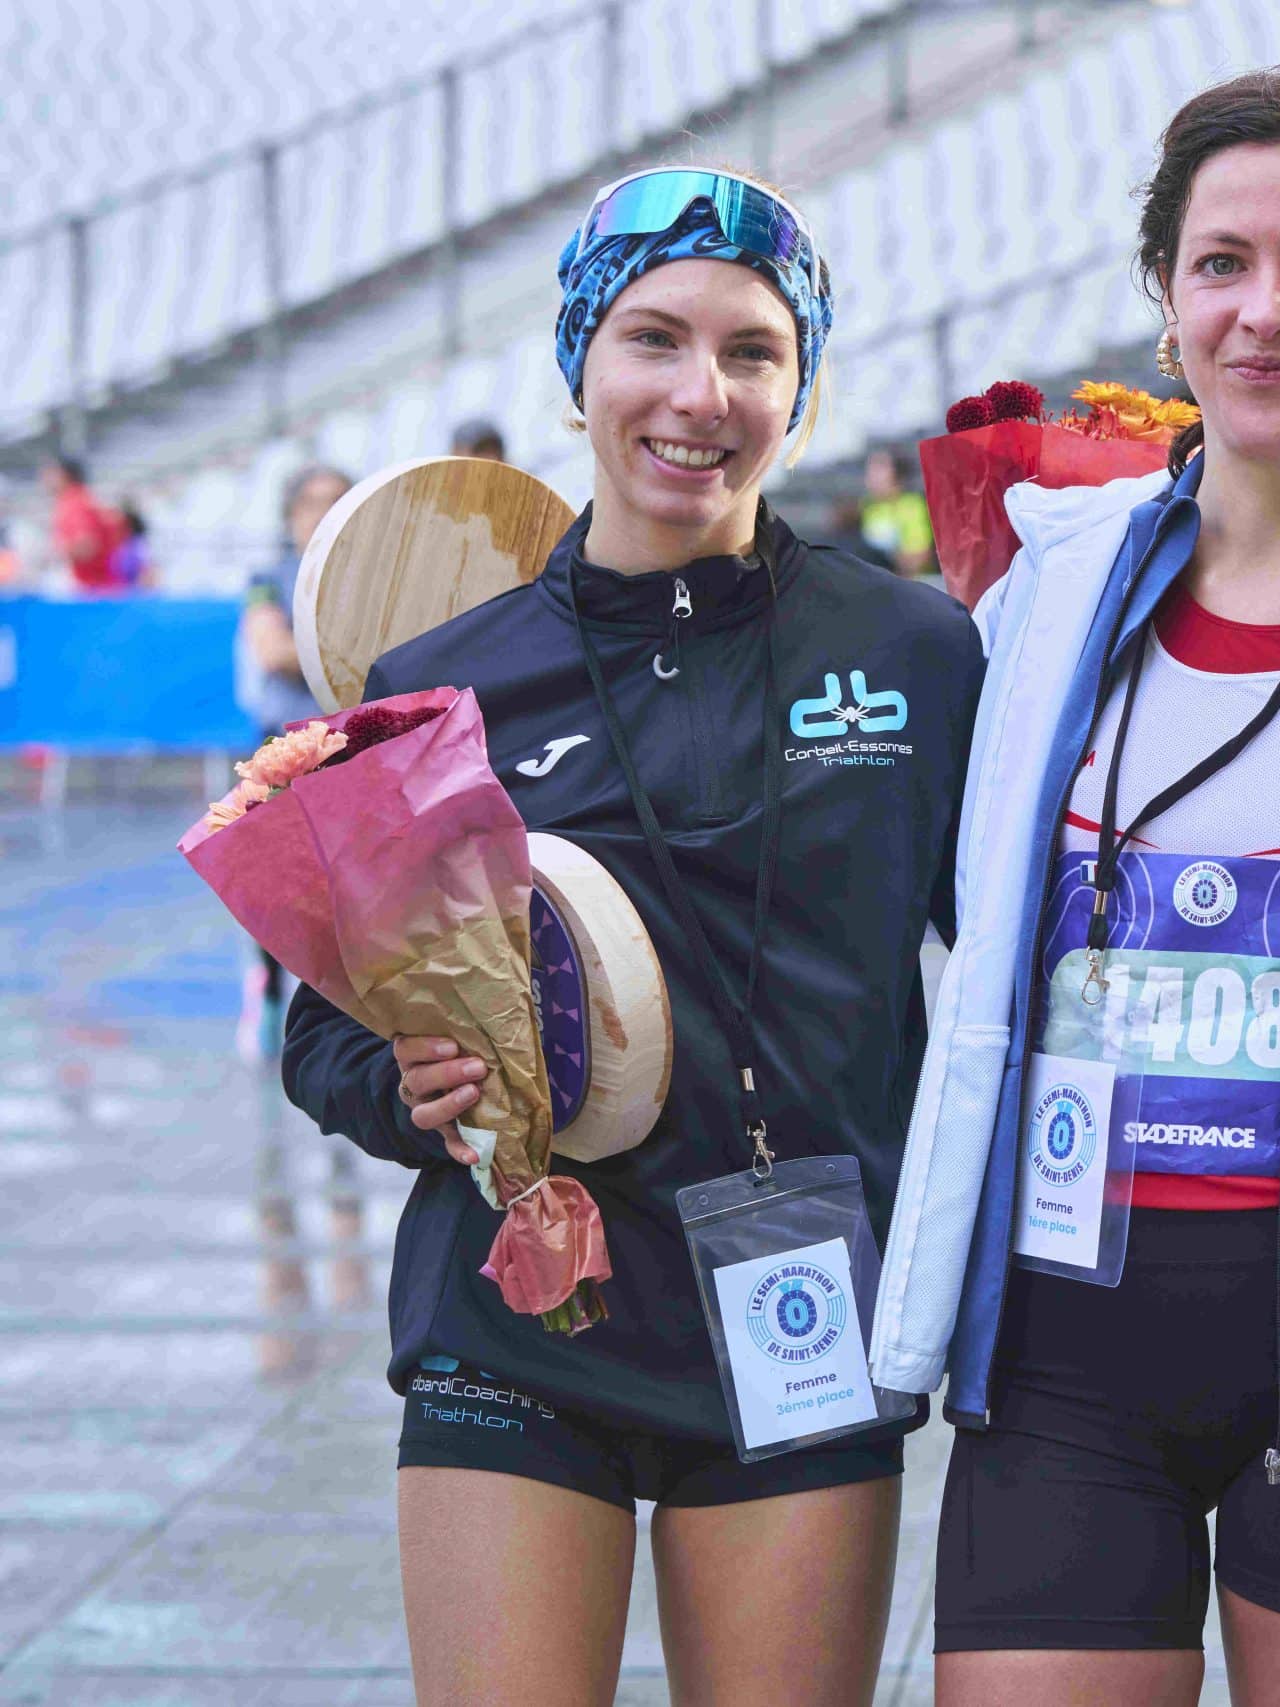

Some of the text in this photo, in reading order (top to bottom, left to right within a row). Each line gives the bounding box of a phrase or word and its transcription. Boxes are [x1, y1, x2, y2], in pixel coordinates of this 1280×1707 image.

[784, 740, 912, 761] Corbeil-Essonnes
[818, 754, 895, 767] Triathlon
[1036, 1088, 1092, 1128] LE SEMI-MARATHON
[1124, 1122, 1256, 1150] STADEFRANCE
[1033, 1154, 1084, 1183] DE SAINT-DENIS
[1036, 1197, 1073, 1214] Femme
[1049, 1219, 1077, 1235] place
[752, 1266, 836, 1311] LE SEMI-MARATHON
[767, 1328, 838, 1361] DE SAINT-DENIS
[785, 1372, 837, 1394] Femme
[817, 1387, 854, 1408] place
[422, 1403, 523, 1432] Triathlon
